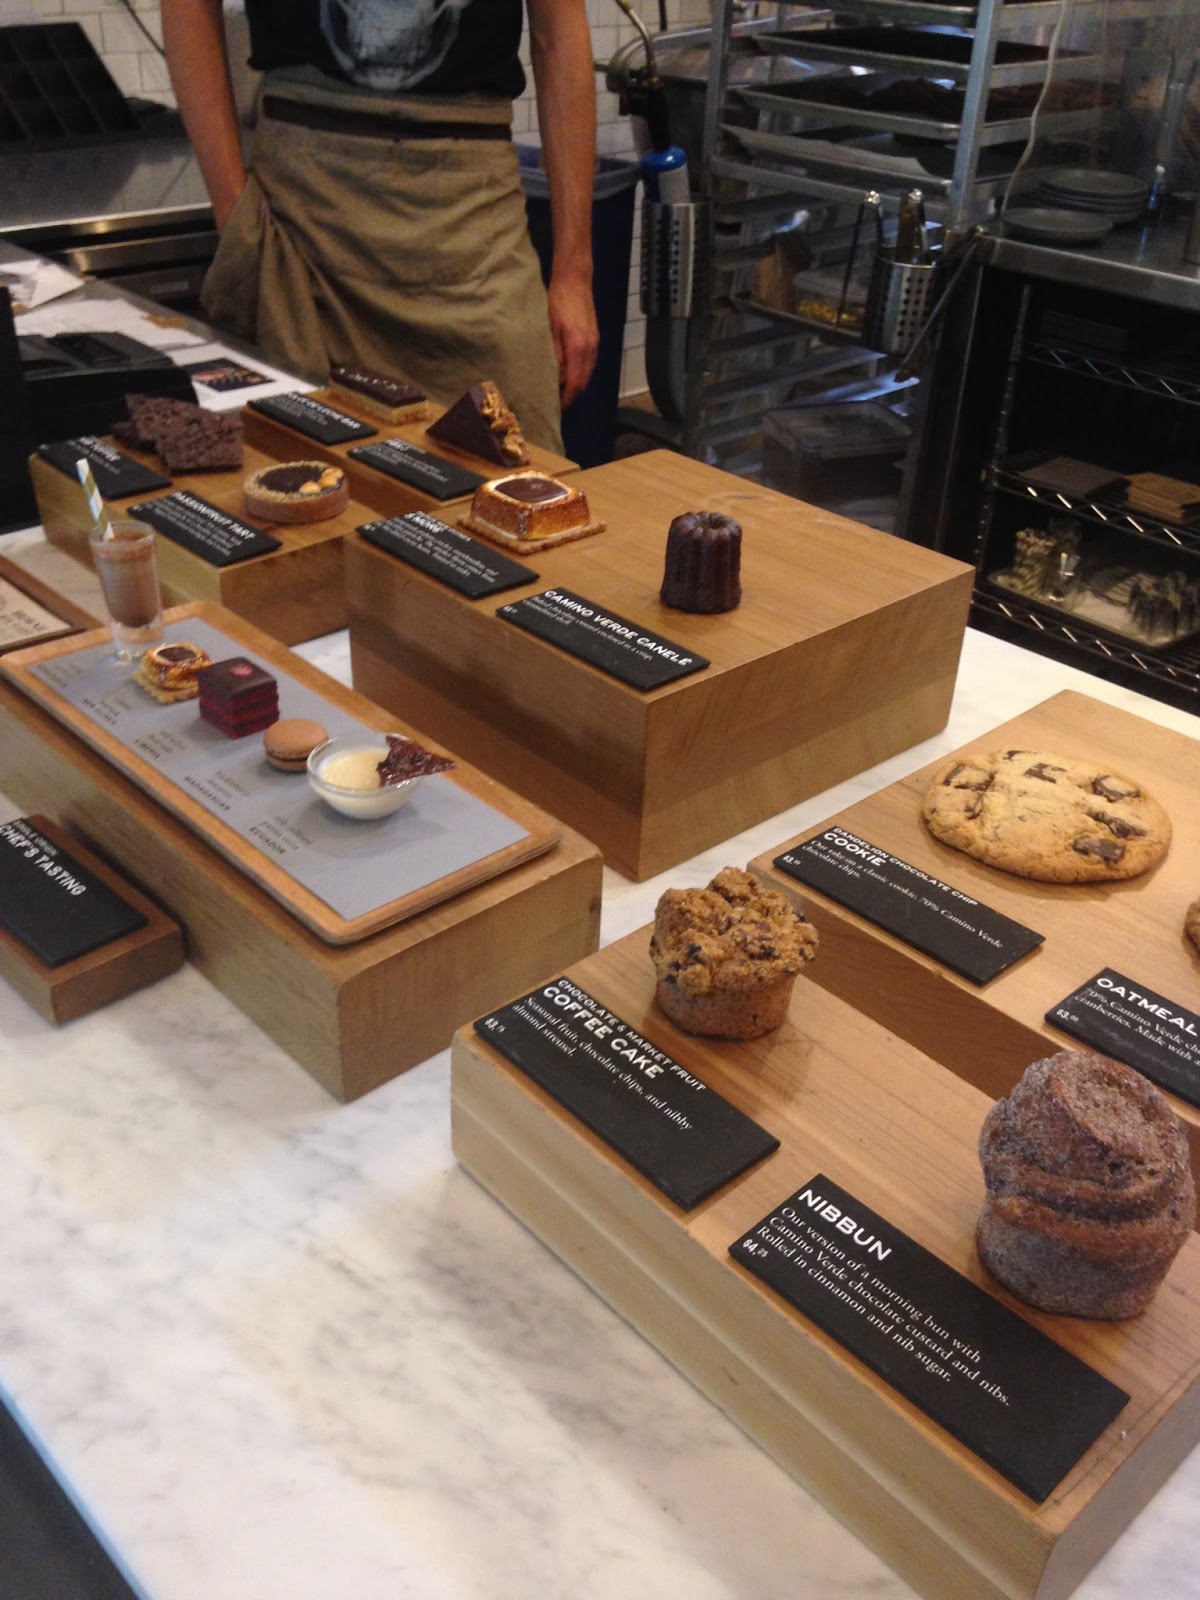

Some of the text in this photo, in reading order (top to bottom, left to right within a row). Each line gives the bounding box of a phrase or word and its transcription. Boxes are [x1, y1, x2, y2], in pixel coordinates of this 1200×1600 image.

[543, 590, 692, 666] CAMINO VERDE CANELÉ
[34, 854, 87, 896] TASTING
[802, 846, 838, 865] chocolate
[824, 833, 886, 866] COOKIE
[833, 828, 978, 905] DANDELION CHOCOLATE CHIP
[940, 910, 976, 932] Camino
[978, 929, 1003, 948] Verde
[512, 1005, 547, 1030] almond
[543, 987, 664, 1079] COFFEE CAKE
[558, 980, 619, 1025] CHOCOLATE
[626, 1031, 672, 1065] MARKET
[670, 1065, 706, 1090] FRUIT
[1097, 978, 1197, 1036] OATMEAL
[1107, 1001, 1151, 1026] Camino
[1155, 1023, 1183, 1044] Verde
[1135, 1025, 1165, 1046] Made
[1168, 1044, 1192, 1060] with
[579, 1042, 620, 1073] chocolate
[645, 1094, 667, 1109] and
[664, 1108, 692, 1129] nibby
[798, 1189, 892, 1261] NIBBUN
[757, 1226, 951, 1382] Rolled in cinnamon and nib sugar.
[770, 1217, 1009, 1406] Camino Verde chocolate custard and nibs.
[780, 1207, 806, 1227] Our
[800, 1227, 846, 1260] version
[843, 1260, 865, 1271] of
[871, 1278, 923, 1320] morning
[924, 1315, 949, 1339] bun
[953, 1339, 980, 1363] with
